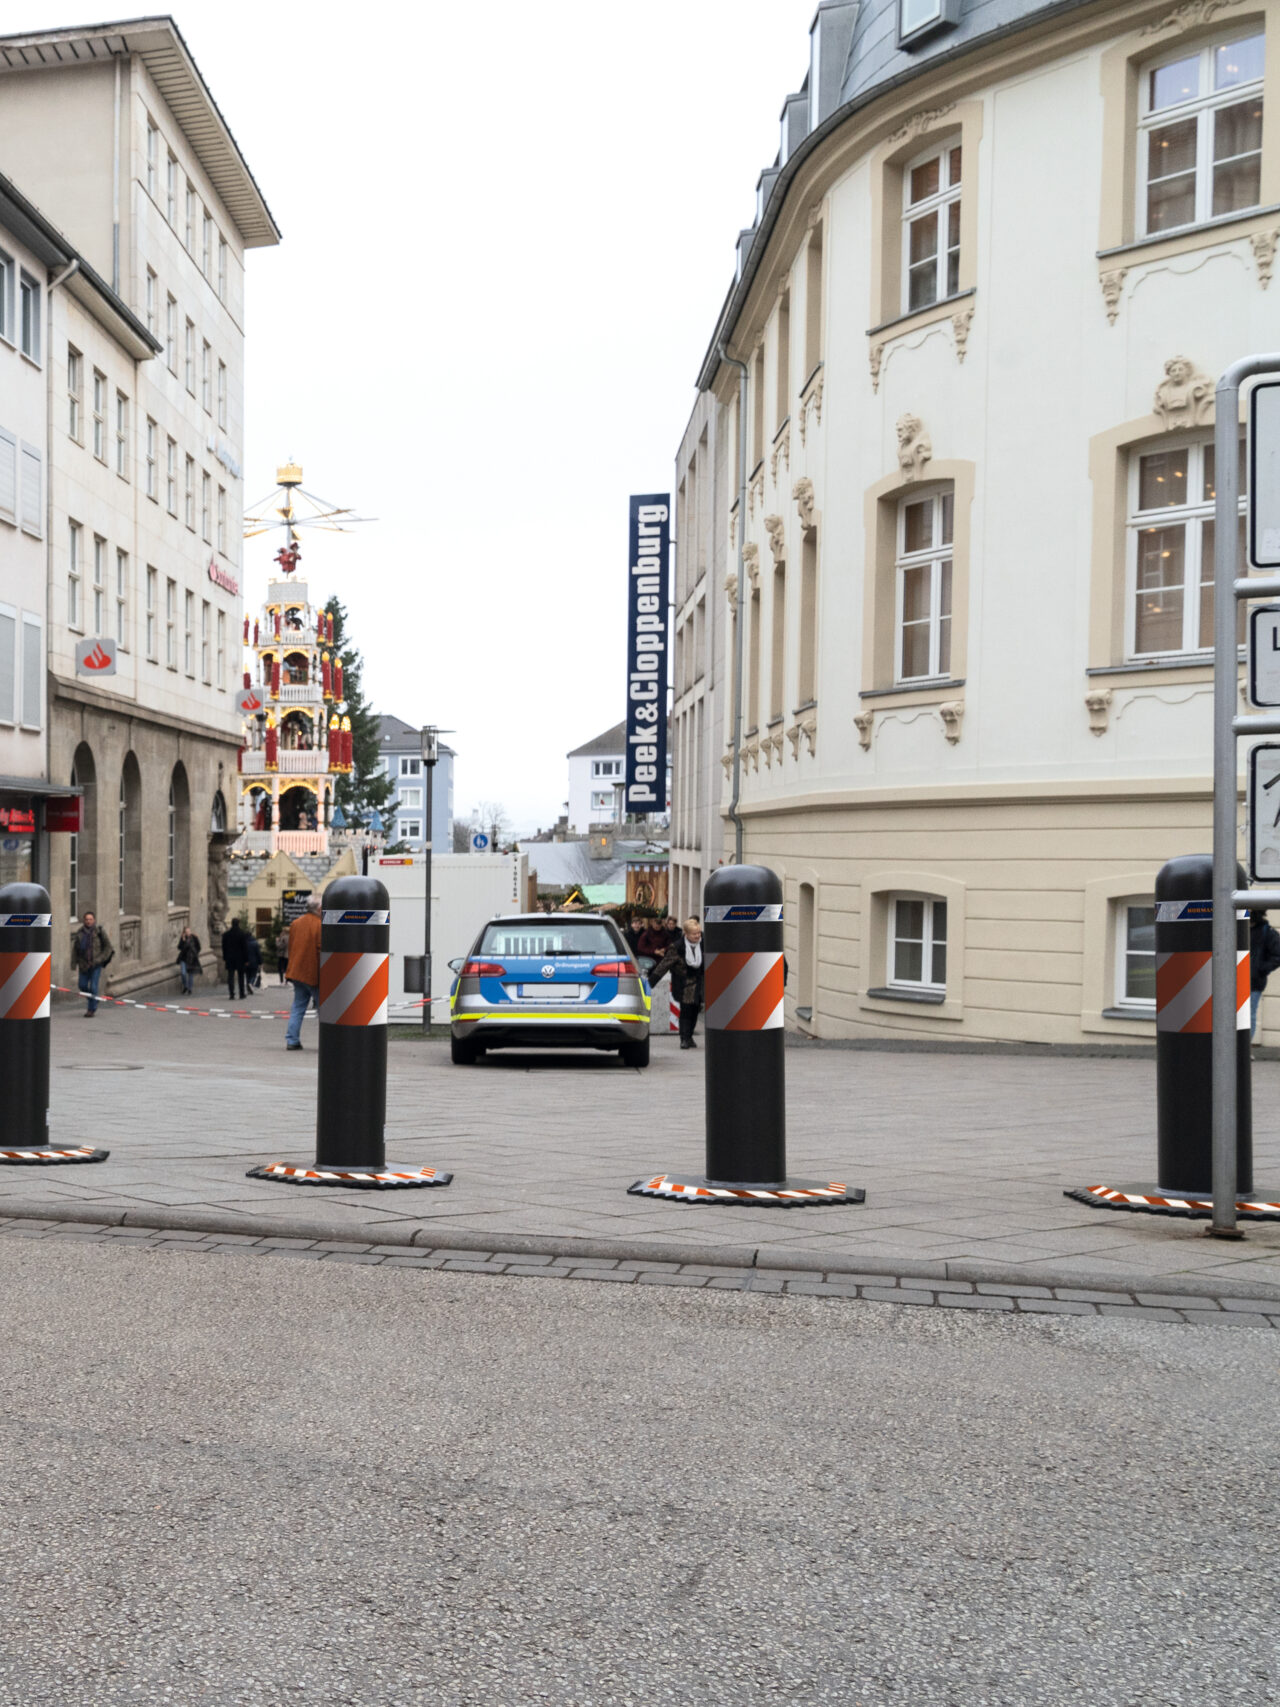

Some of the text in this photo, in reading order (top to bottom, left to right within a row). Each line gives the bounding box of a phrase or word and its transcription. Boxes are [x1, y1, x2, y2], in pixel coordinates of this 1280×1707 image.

[628, 503, 668, 802] Peek & Cloppenburg
